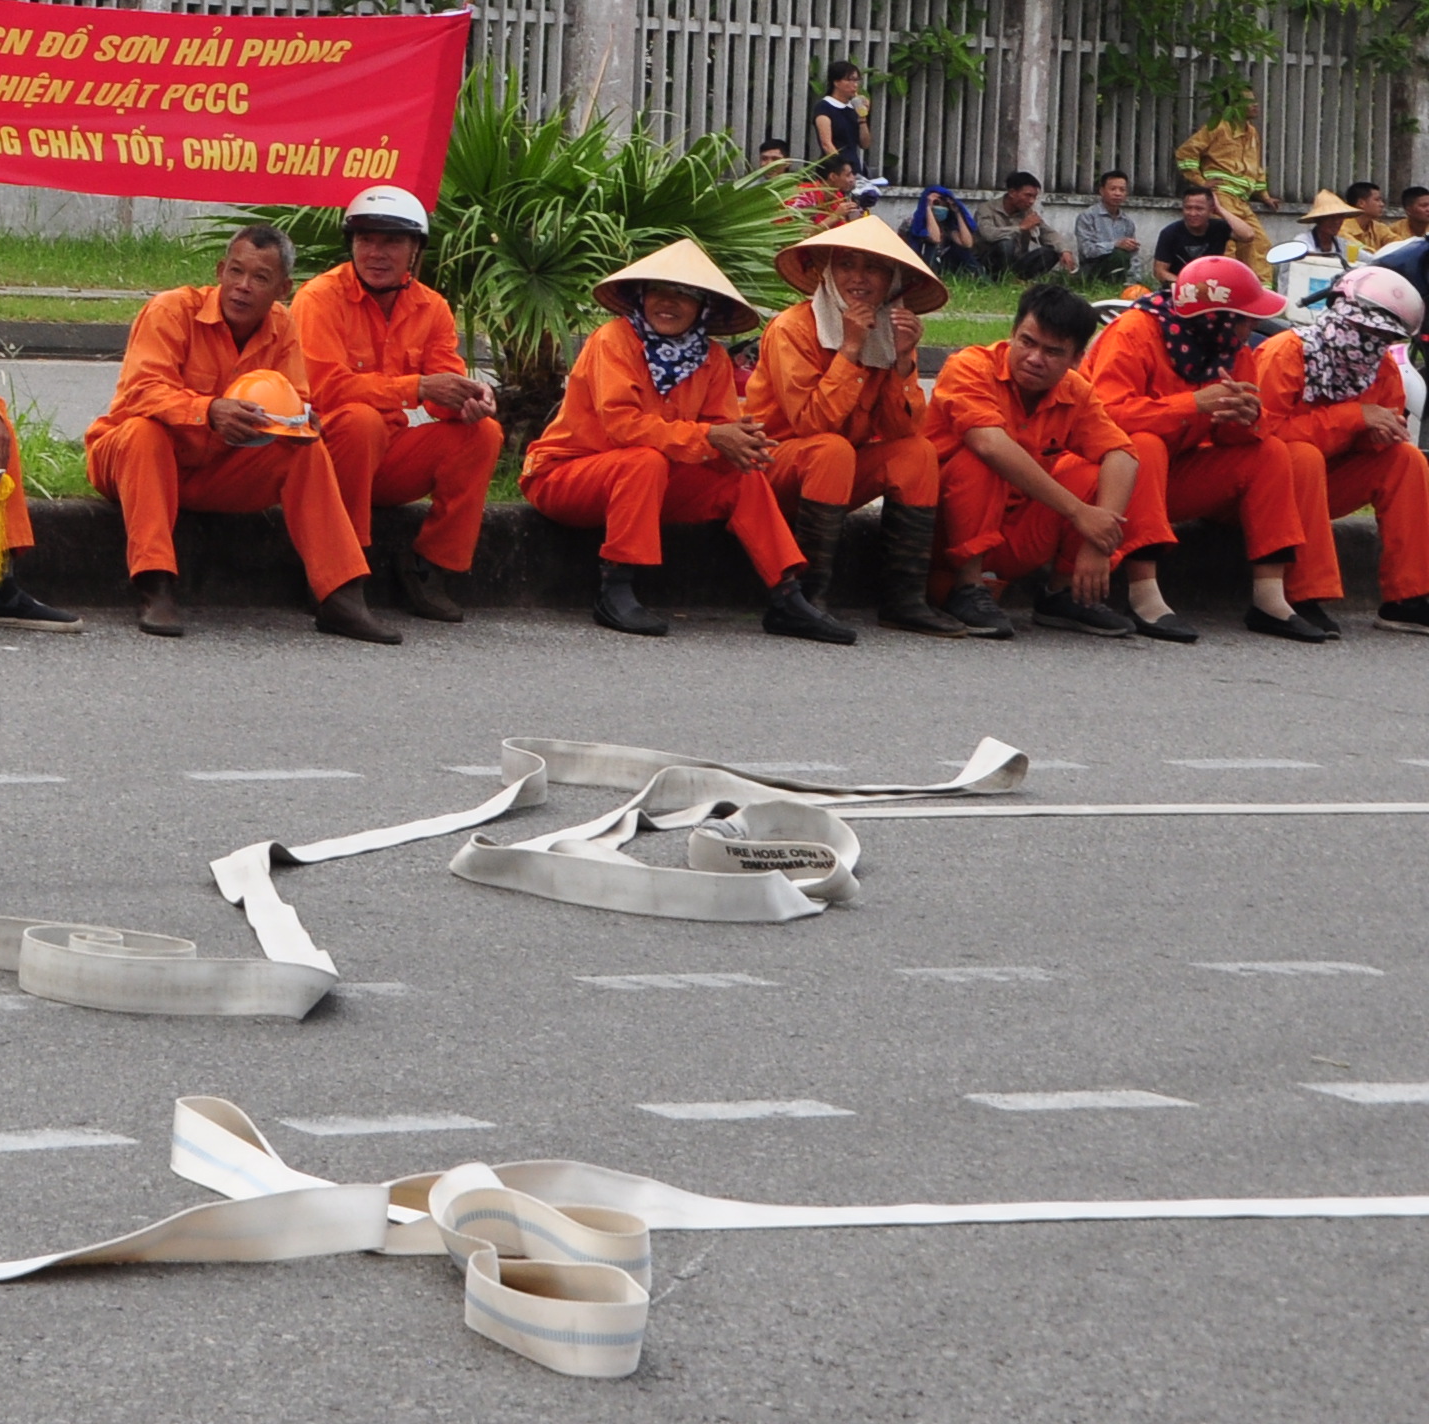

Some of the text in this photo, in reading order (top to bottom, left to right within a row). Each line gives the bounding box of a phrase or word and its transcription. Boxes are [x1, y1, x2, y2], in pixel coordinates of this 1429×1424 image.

[35, 23, 95, 60] ĐỒ
[93, 33, 171, 66] SƠN
[171, 25, 234, 67] HẢI
[236, 31, 353, 67] PHÒNG
[74, 78, 161, 115] LUẬT
[160, 82, 250, 115] PCCC
[28, 124, 105, 162] CHÁY
[111, 125, 175, 172] TỐT,
[182, 132, 258, 173] CHỮA
[266, 138, 341, 177] CHÁY
[342, 135, 400, 180] GIỎI
[725, 845, 750, 858] FIRE
[751, 848, 788, 860] HOSE
